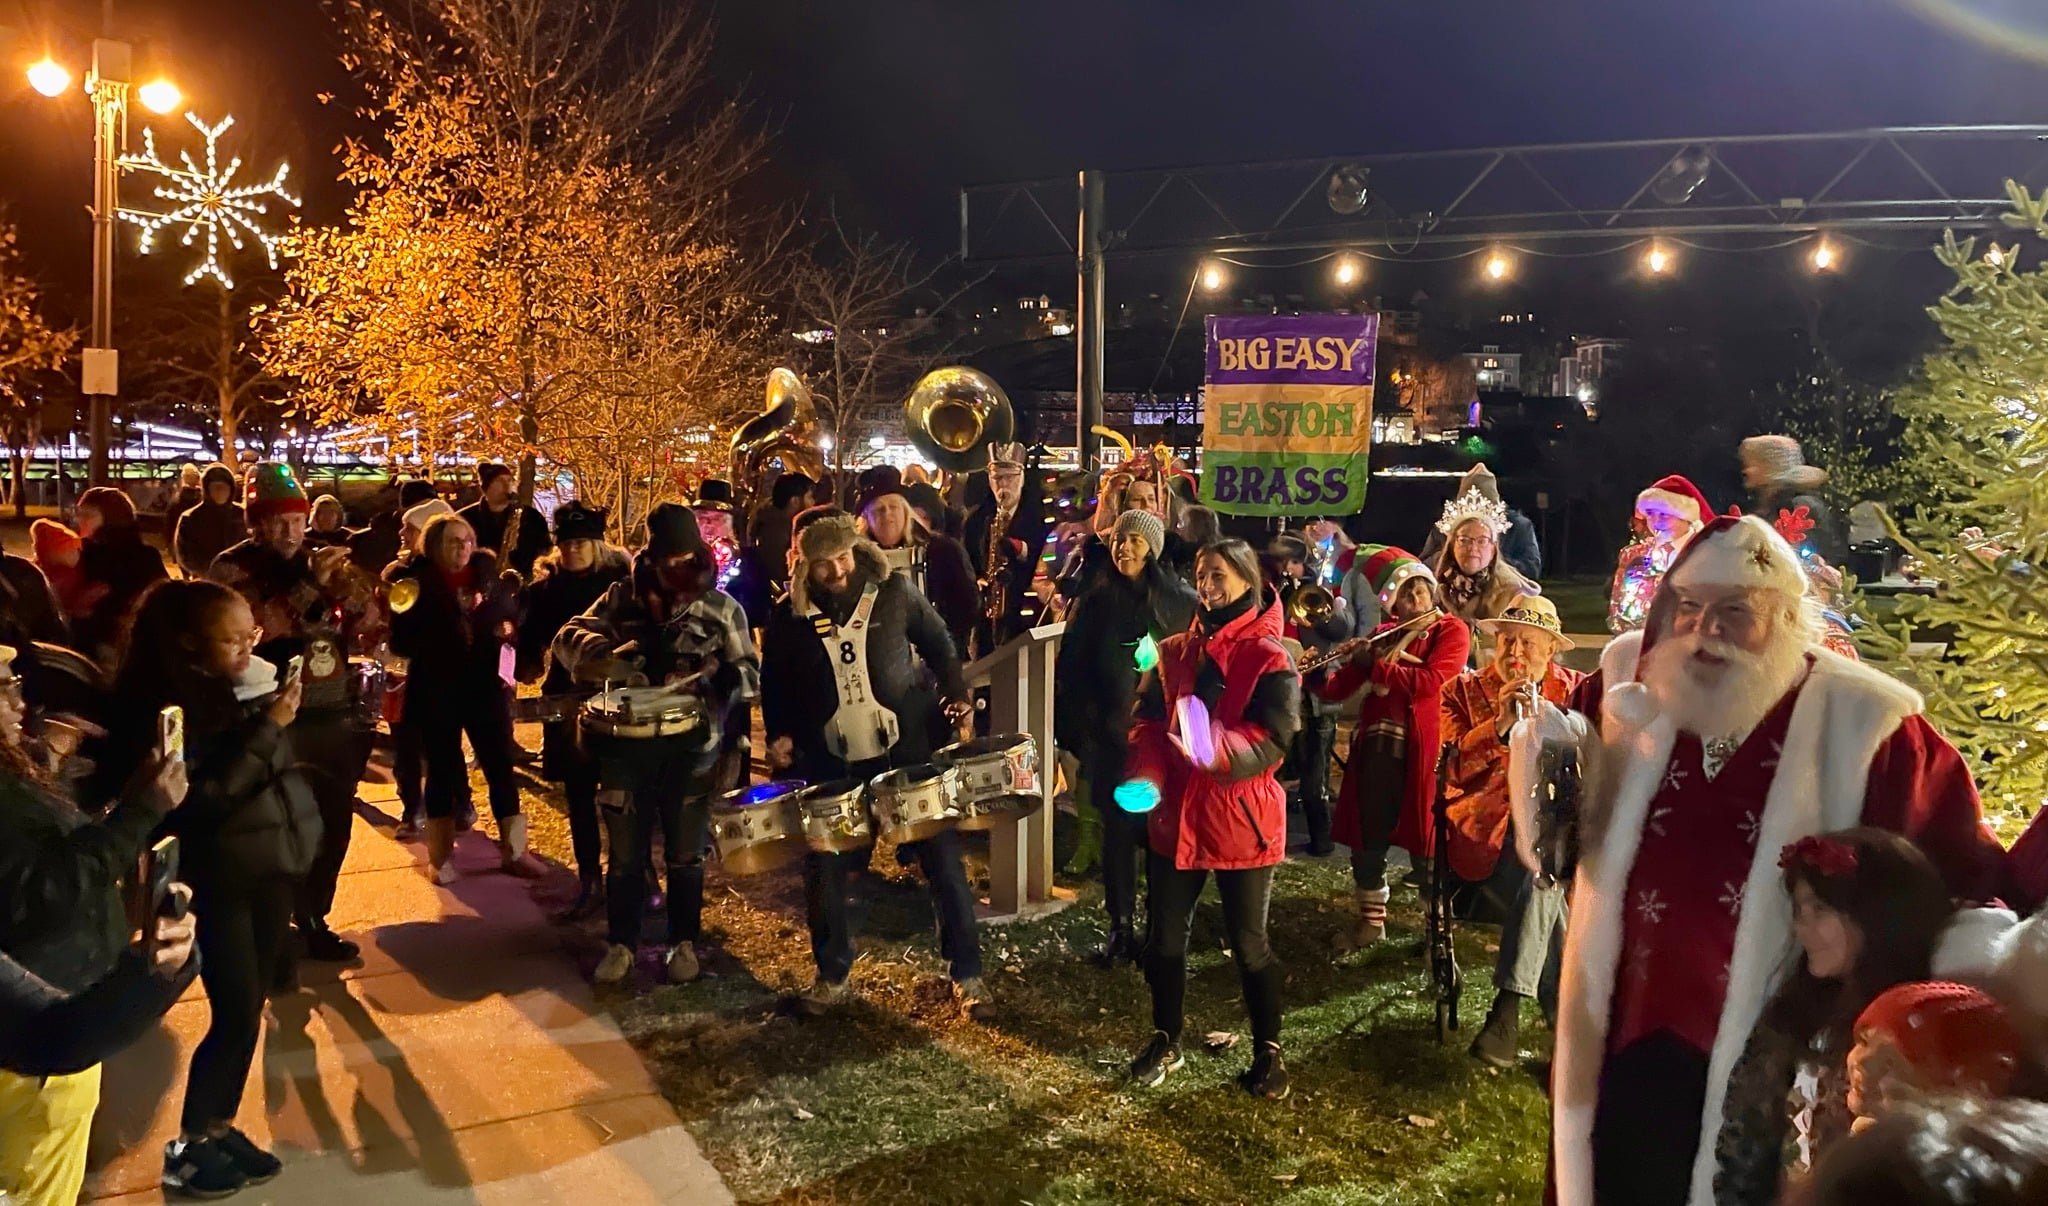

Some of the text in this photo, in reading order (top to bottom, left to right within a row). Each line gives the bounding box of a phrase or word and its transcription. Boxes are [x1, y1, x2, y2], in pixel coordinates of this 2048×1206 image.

[1219, 337, 1361, 371] BIG EASY
[1219, 402, 1353, 438] EASTON
[1215, 465, 1348, 505] BRASS
[840, 641, 856, 664] 8
